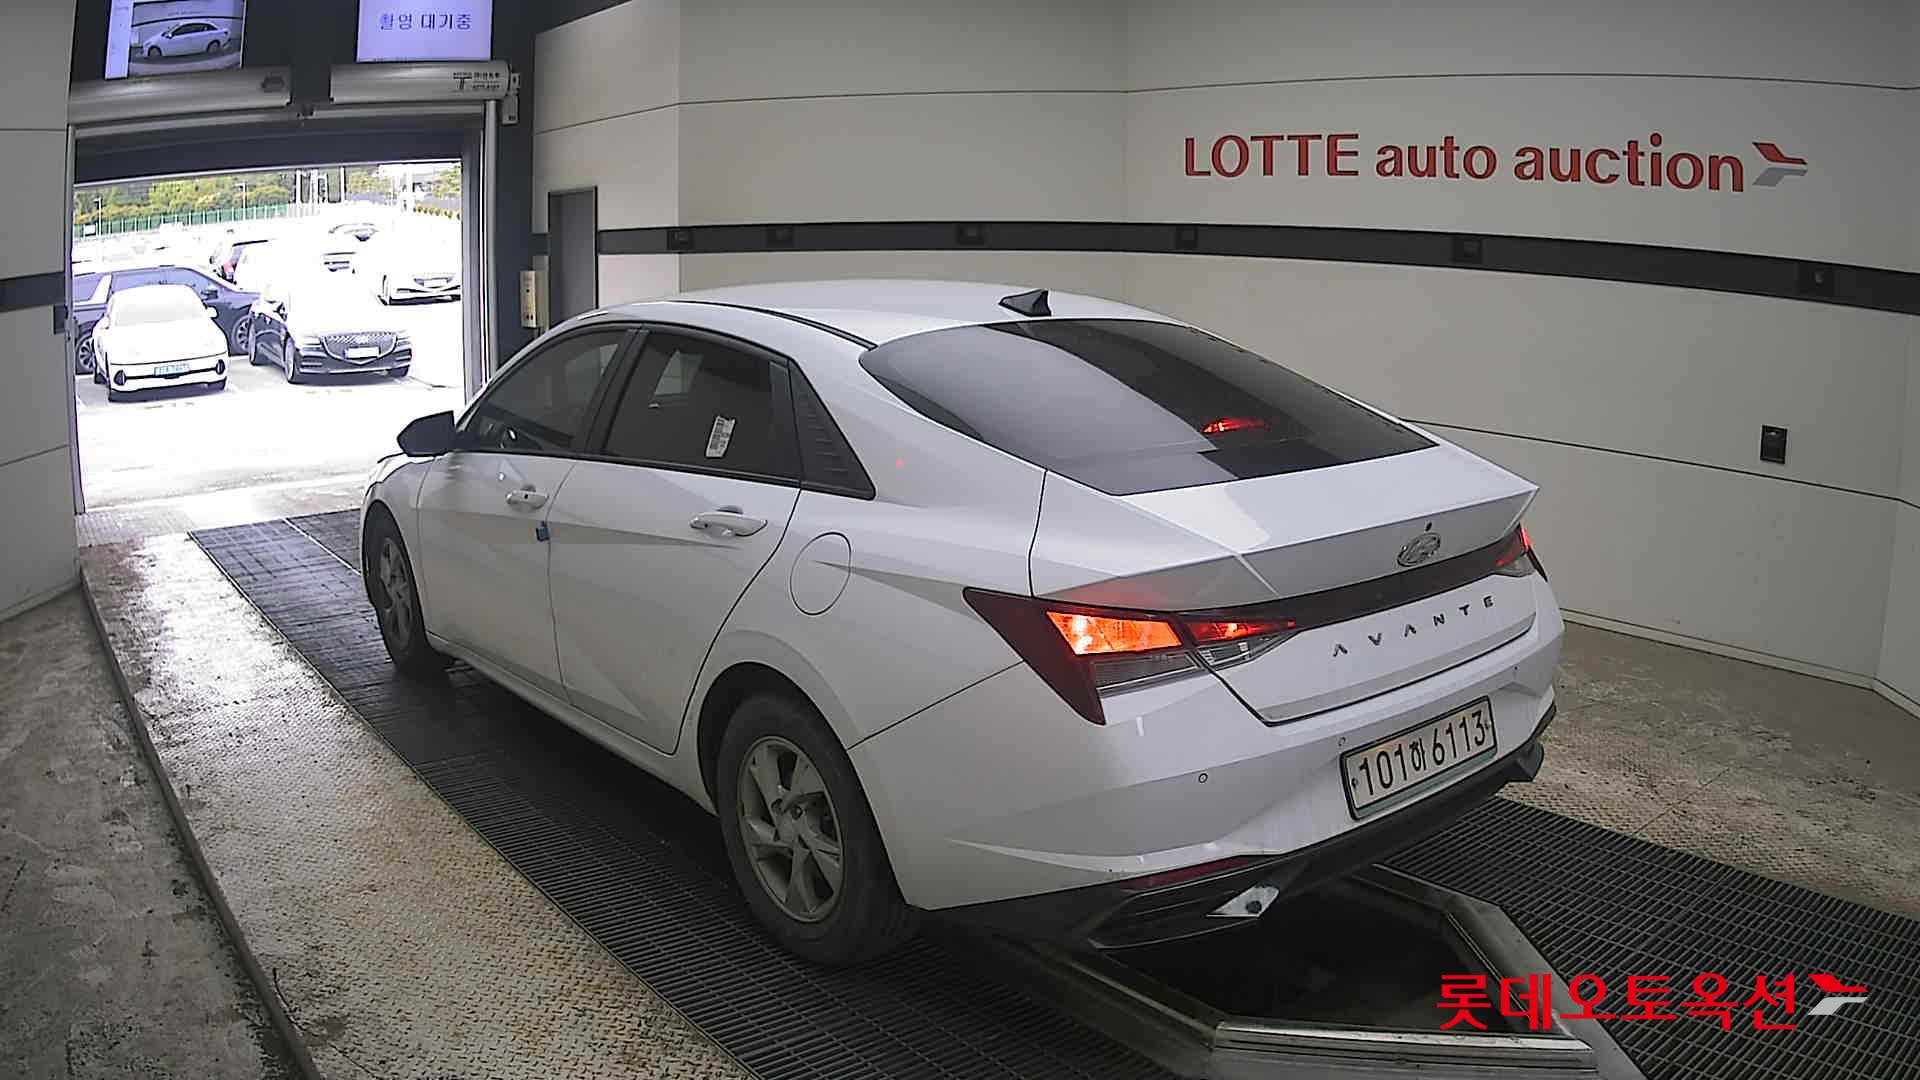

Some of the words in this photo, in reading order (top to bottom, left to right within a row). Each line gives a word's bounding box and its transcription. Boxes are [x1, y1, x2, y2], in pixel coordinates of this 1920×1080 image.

[421, 13, 473, 31] 대기중
[1185, 133, 1359, 176] LOTTE
[1377, 136, 1497, 180] auto
[1515, 133, 1744, 193] auction
[1332, 595, 1495, 658] AVANTE
[1358, 709, 1486, 796] 101하6113
